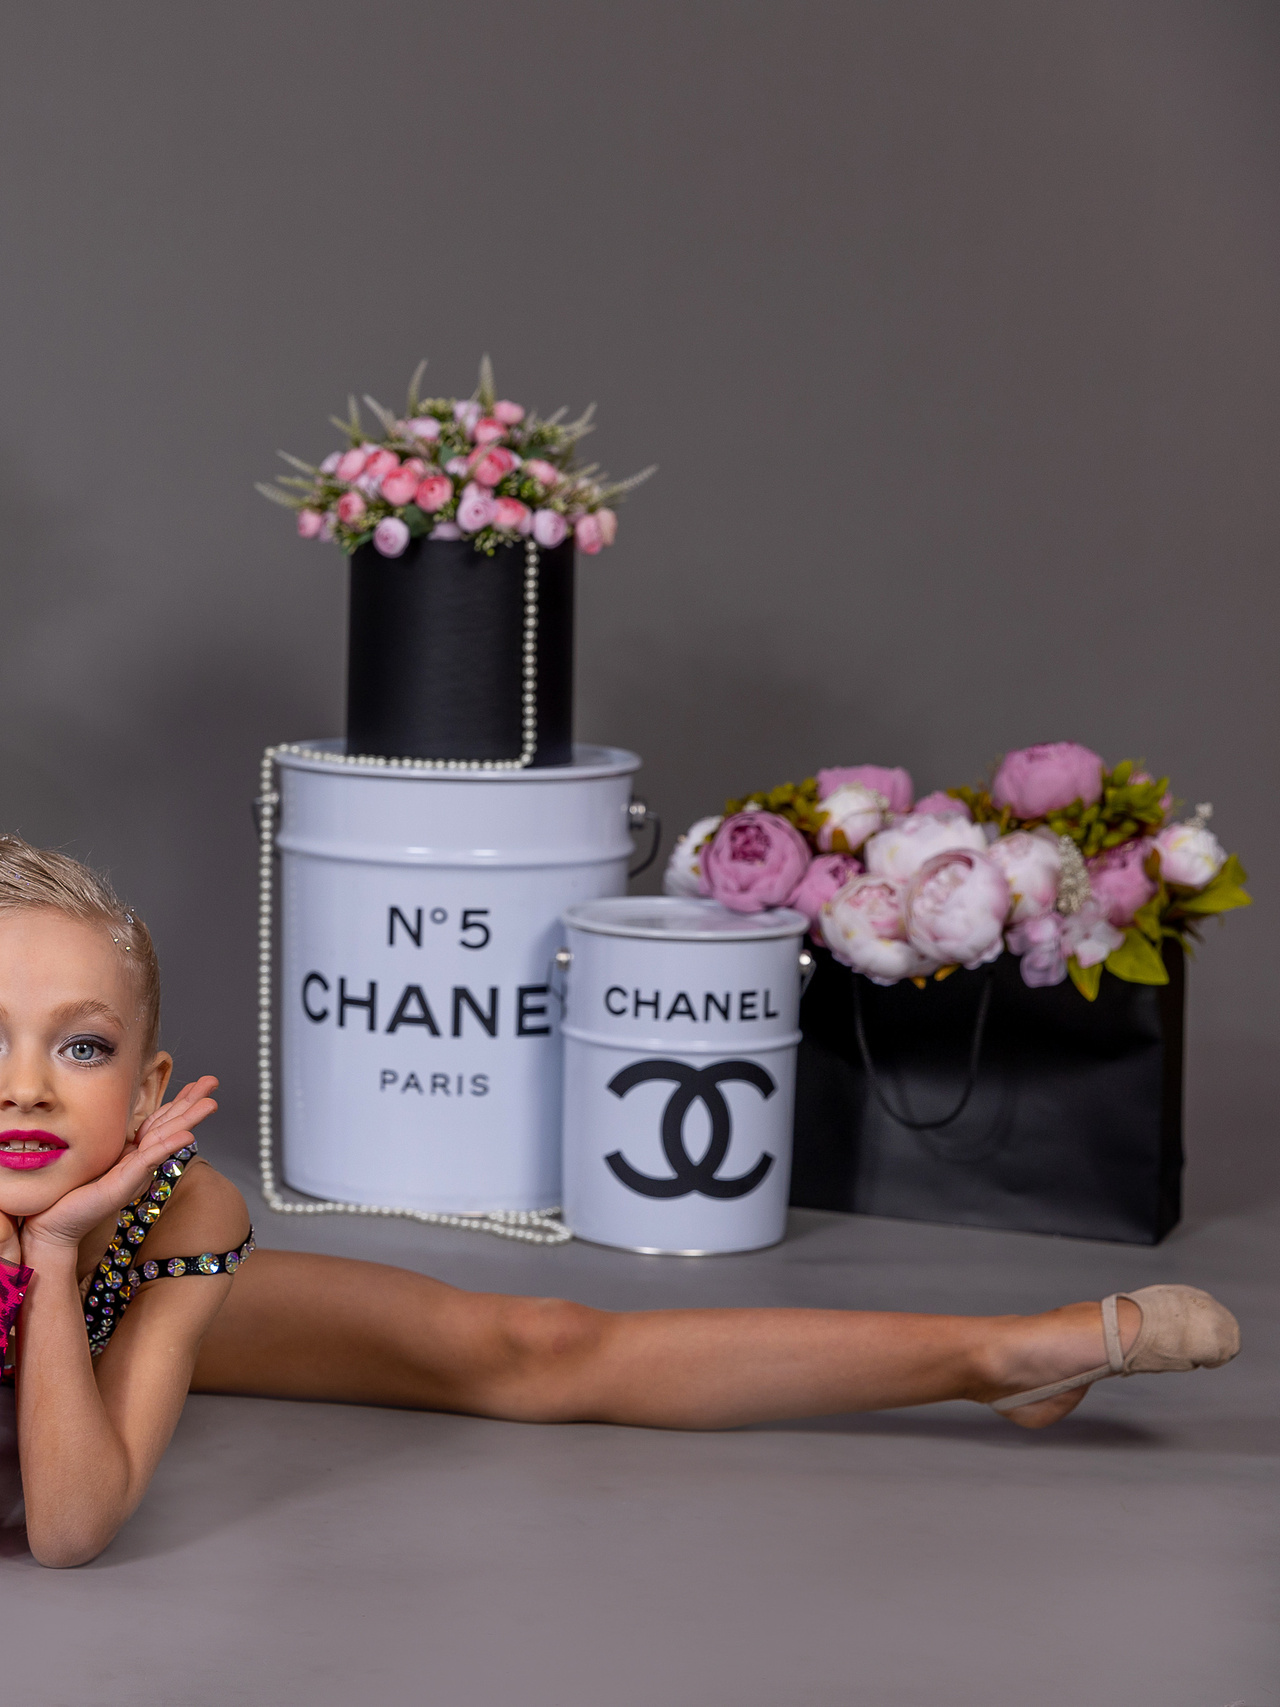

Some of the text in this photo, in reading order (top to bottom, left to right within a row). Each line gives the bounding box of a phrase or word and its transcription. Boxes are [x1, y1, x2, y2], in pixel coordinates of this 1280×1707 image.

[460, 909, 491, 950] 5
[301, 970, 552, 1039] CHANE
[604, 986, 779, 1023] CHANEL
[380, 1069, 490, 1097] PARIS
